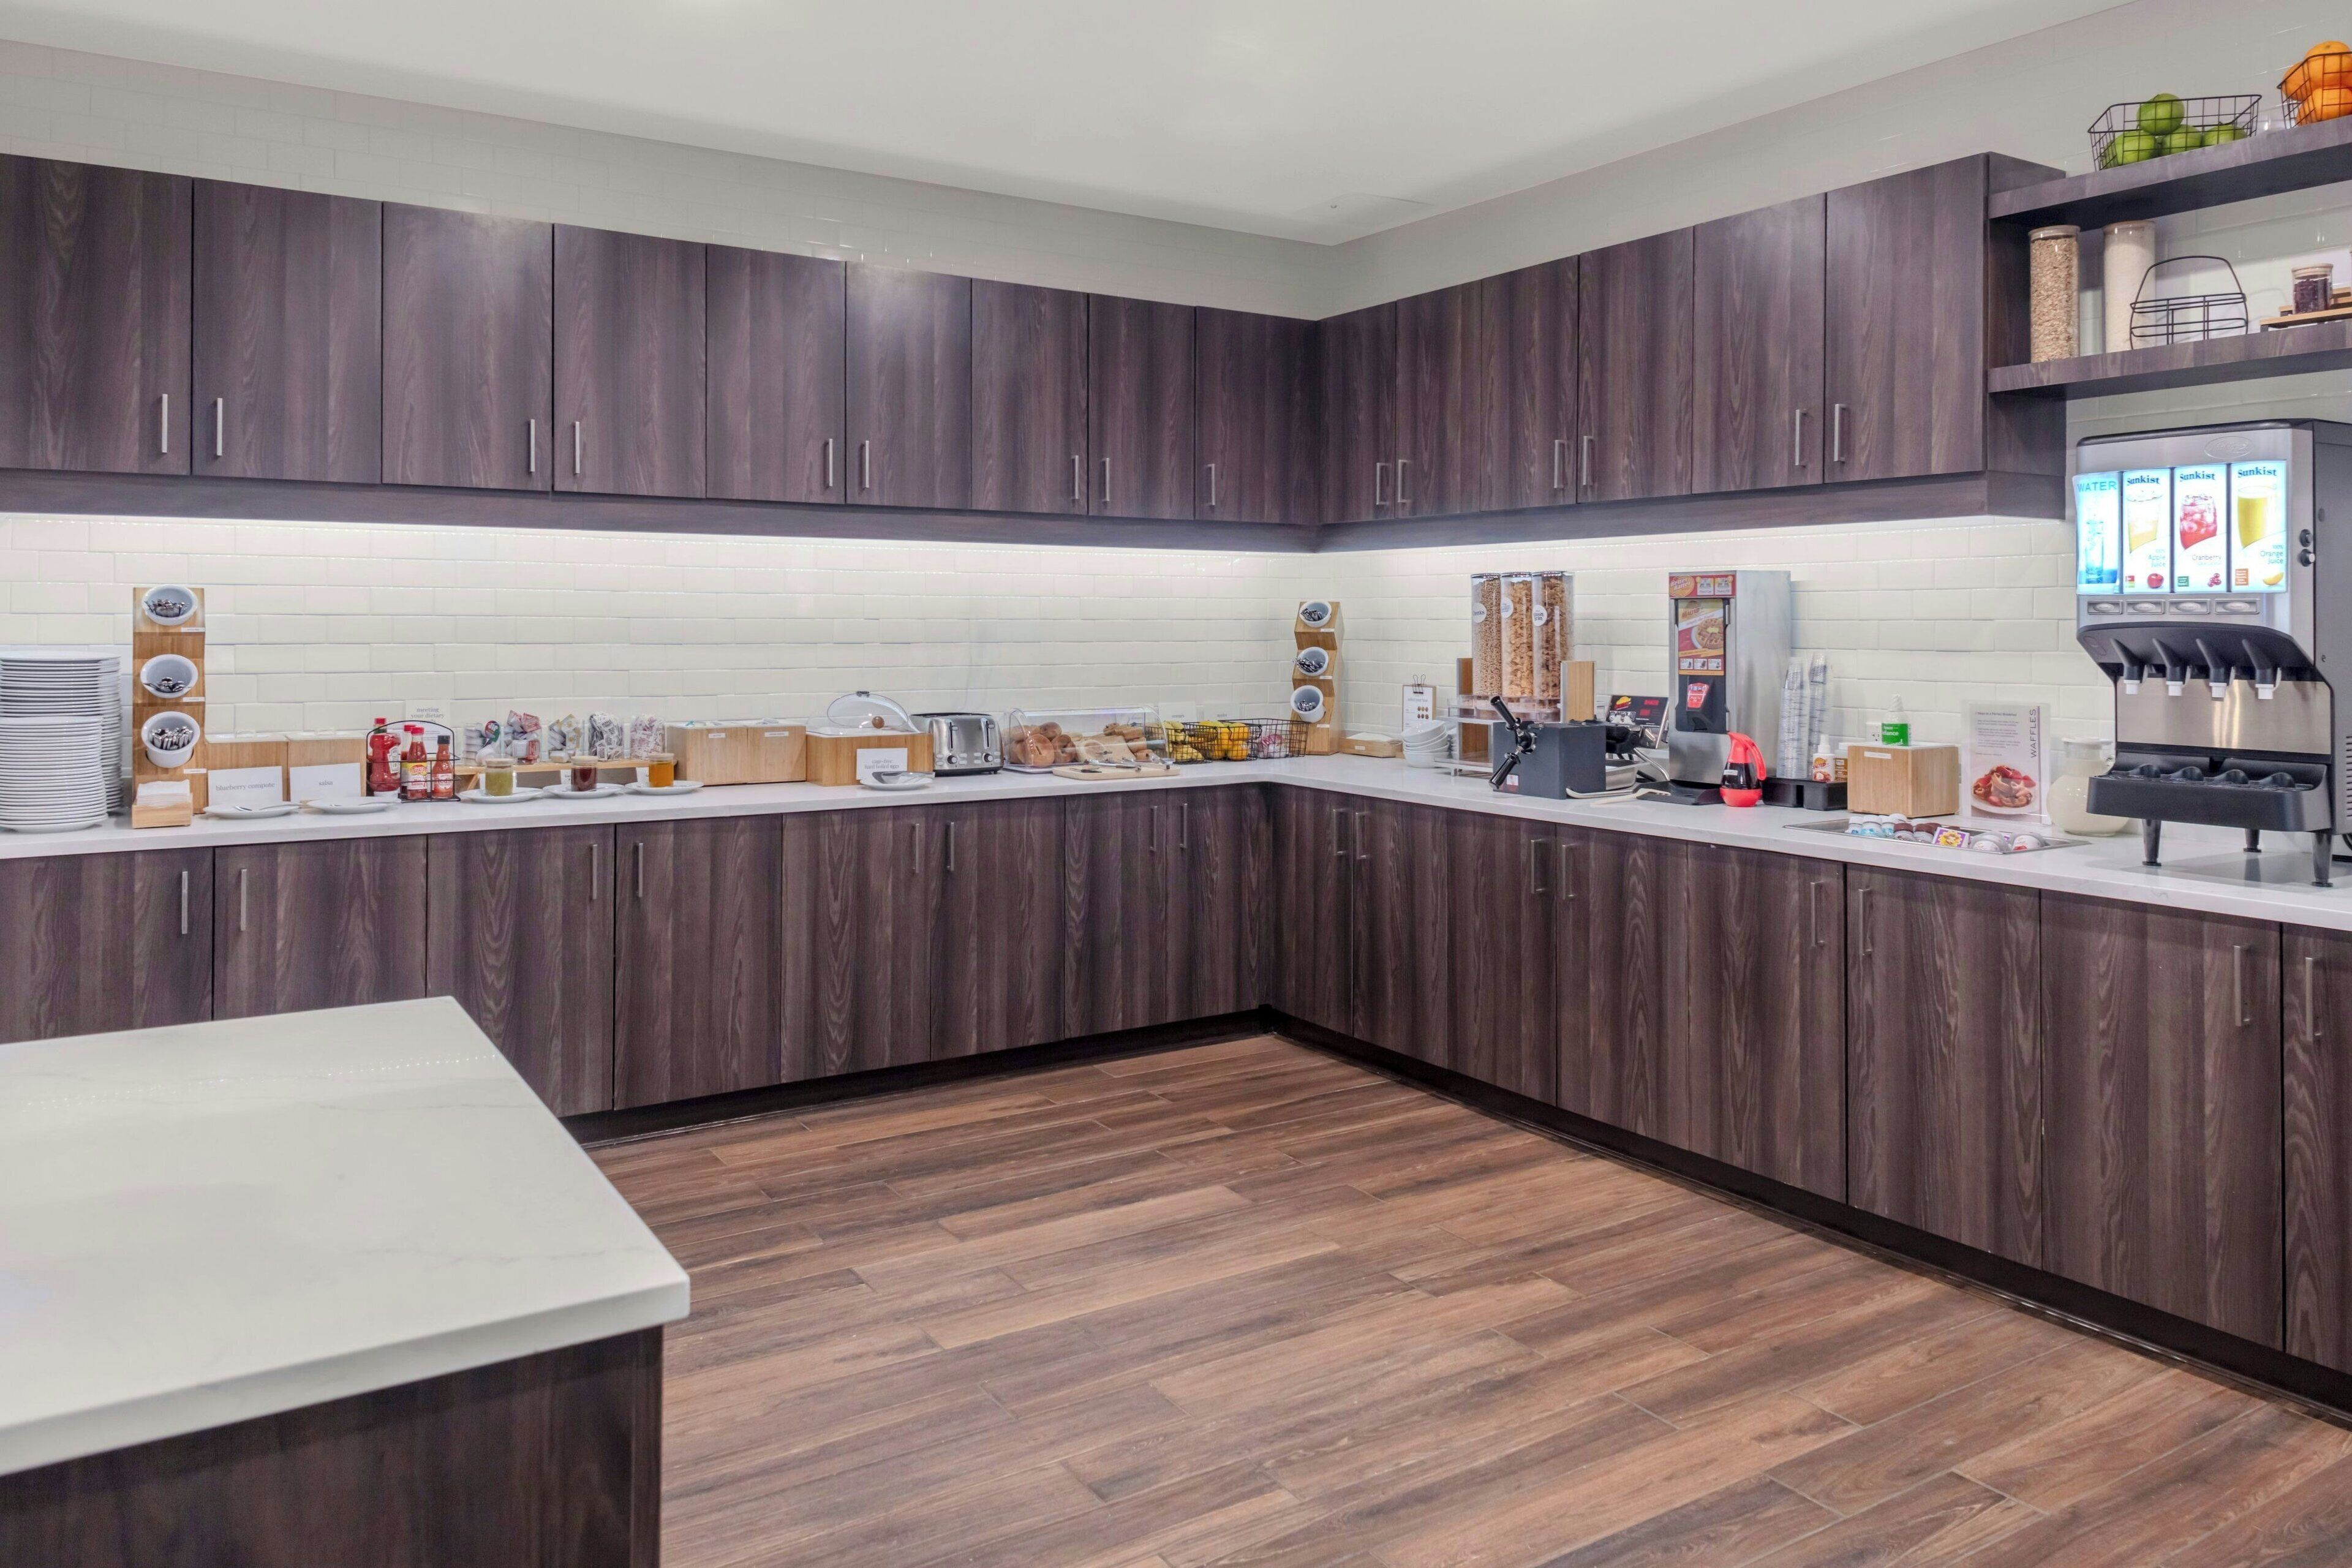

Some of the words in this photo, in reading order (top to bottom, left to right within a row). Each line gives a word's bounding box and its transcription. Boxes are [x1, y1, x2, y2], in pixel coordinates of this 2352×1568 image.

[2179, 470, 2216, 481] Sunkist
[2238, 467, 2277, 478] Sunkist
[2127, 475, 2160, 486] Sunkist
[2077, 481, 2117, 492] WATER
[247, 782, 275, 791] compote
